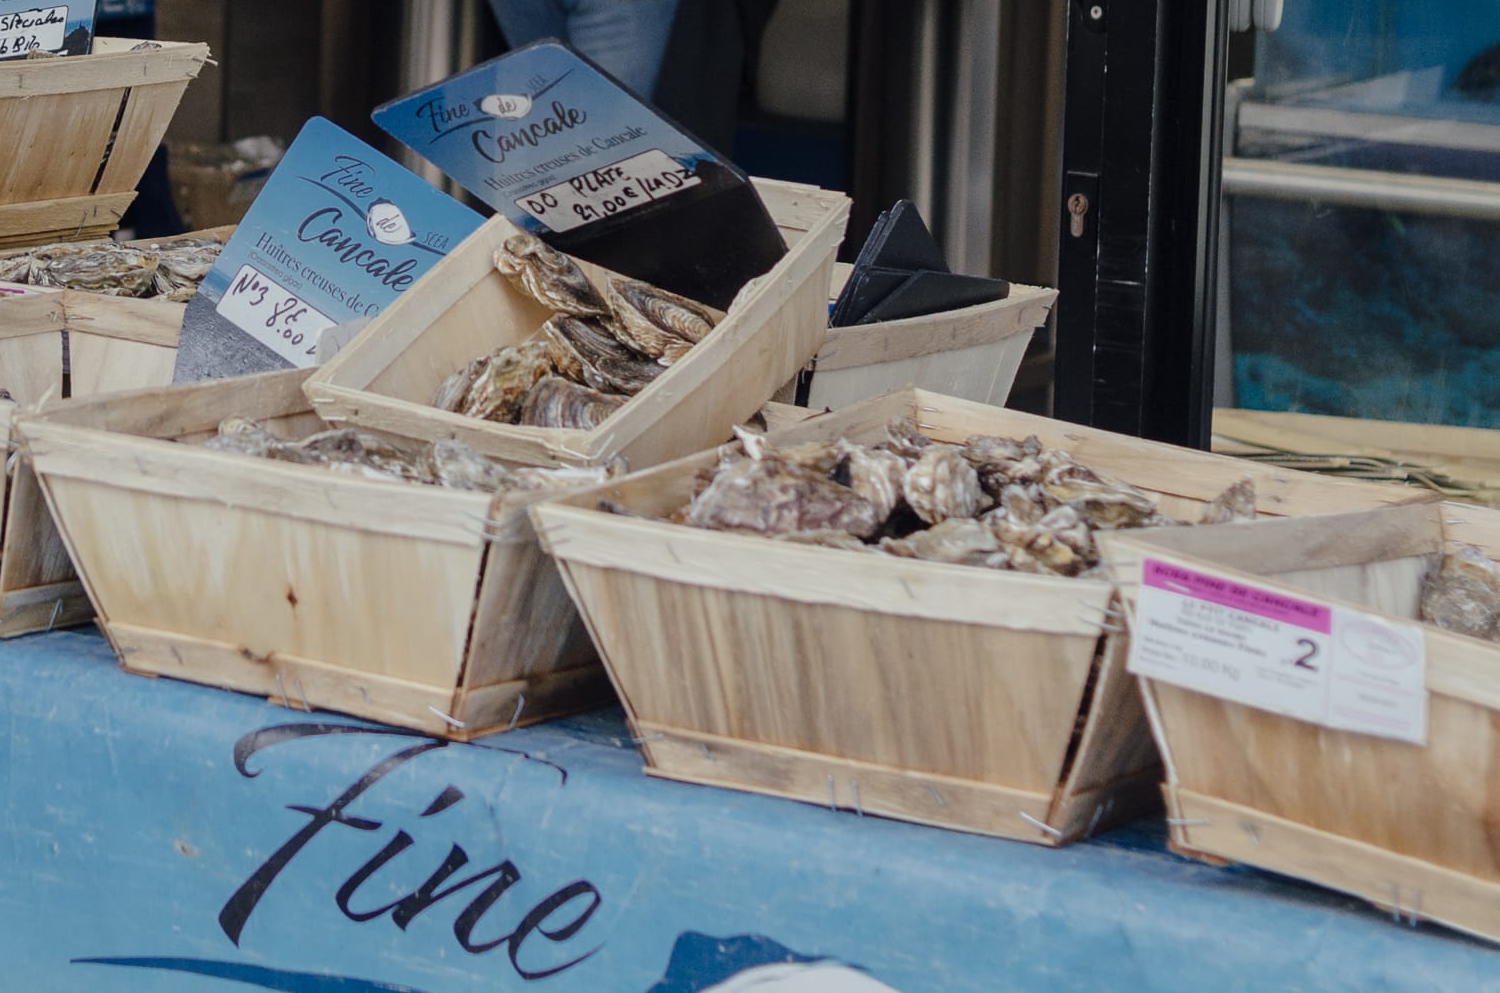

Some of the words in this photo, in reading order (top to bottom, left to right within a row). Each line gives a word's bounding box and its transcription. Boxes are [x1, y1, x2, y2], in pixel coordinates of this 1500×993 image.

[415, 96, 470, 135] Fine
[497, 96, 516, 113] de
[472, 100, 587, 163] Cancale
[578, 144, 594, 157] de
[591, 124, 649, 151] Cancale
[319, 155, 375, 199] Fine
[376, 213, 401, 234] de
[569, 166, 631, 198] PLATE
[297, 207, 419, 293] Cancale
[422, 231, 449, 250] SCEA
[254, 231, 302, 273] Huîtres
[300, 265, 348, 303] creuses
[346, 293, 365, 314] de
[1295, 638, 1319, 672] 2
[217, 722, 606, 981] Fine
